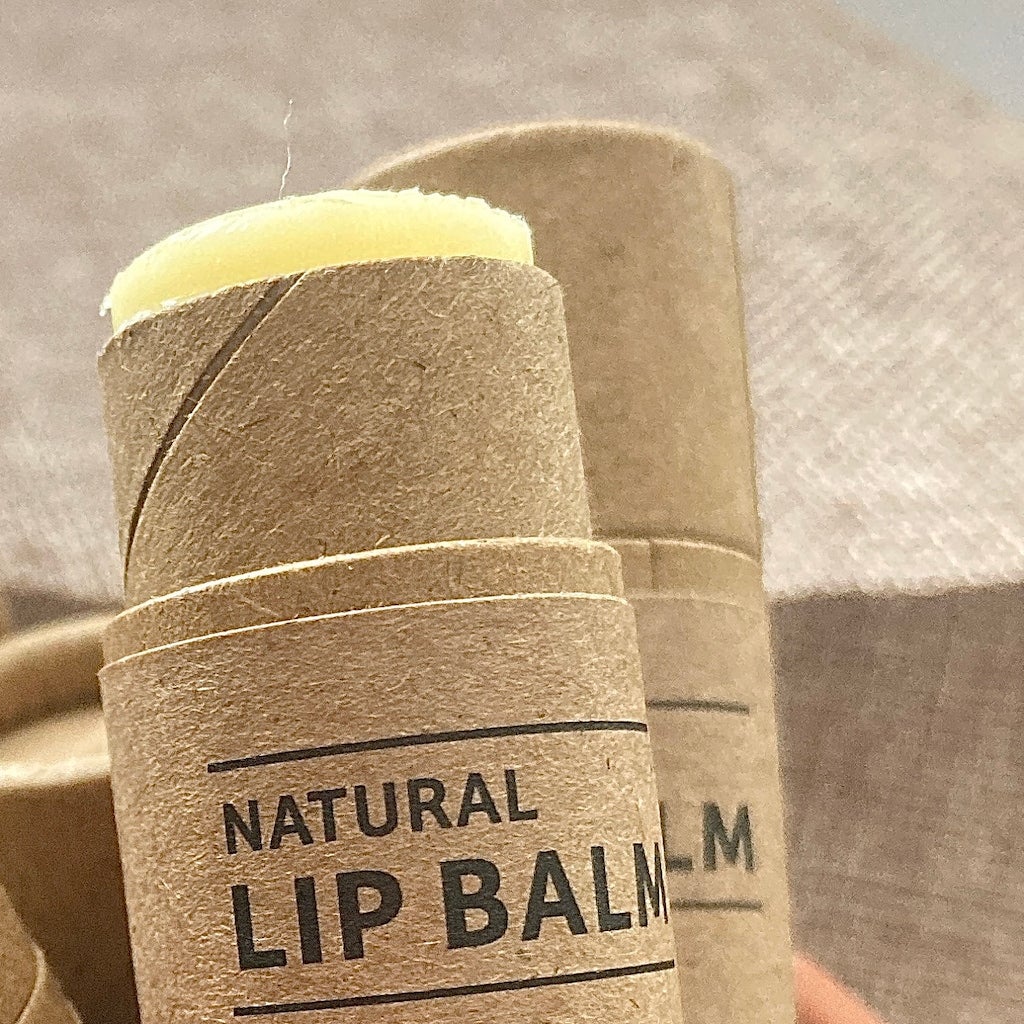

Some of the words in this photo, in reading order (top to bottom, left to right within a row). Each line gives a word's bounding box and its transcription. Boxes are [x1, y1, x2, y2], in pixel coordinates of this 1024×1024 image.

[223, 769, 539, 855] NATURAL
[231, 868, 403, 972] LIP
[439, 841, 669, 951] BALM
